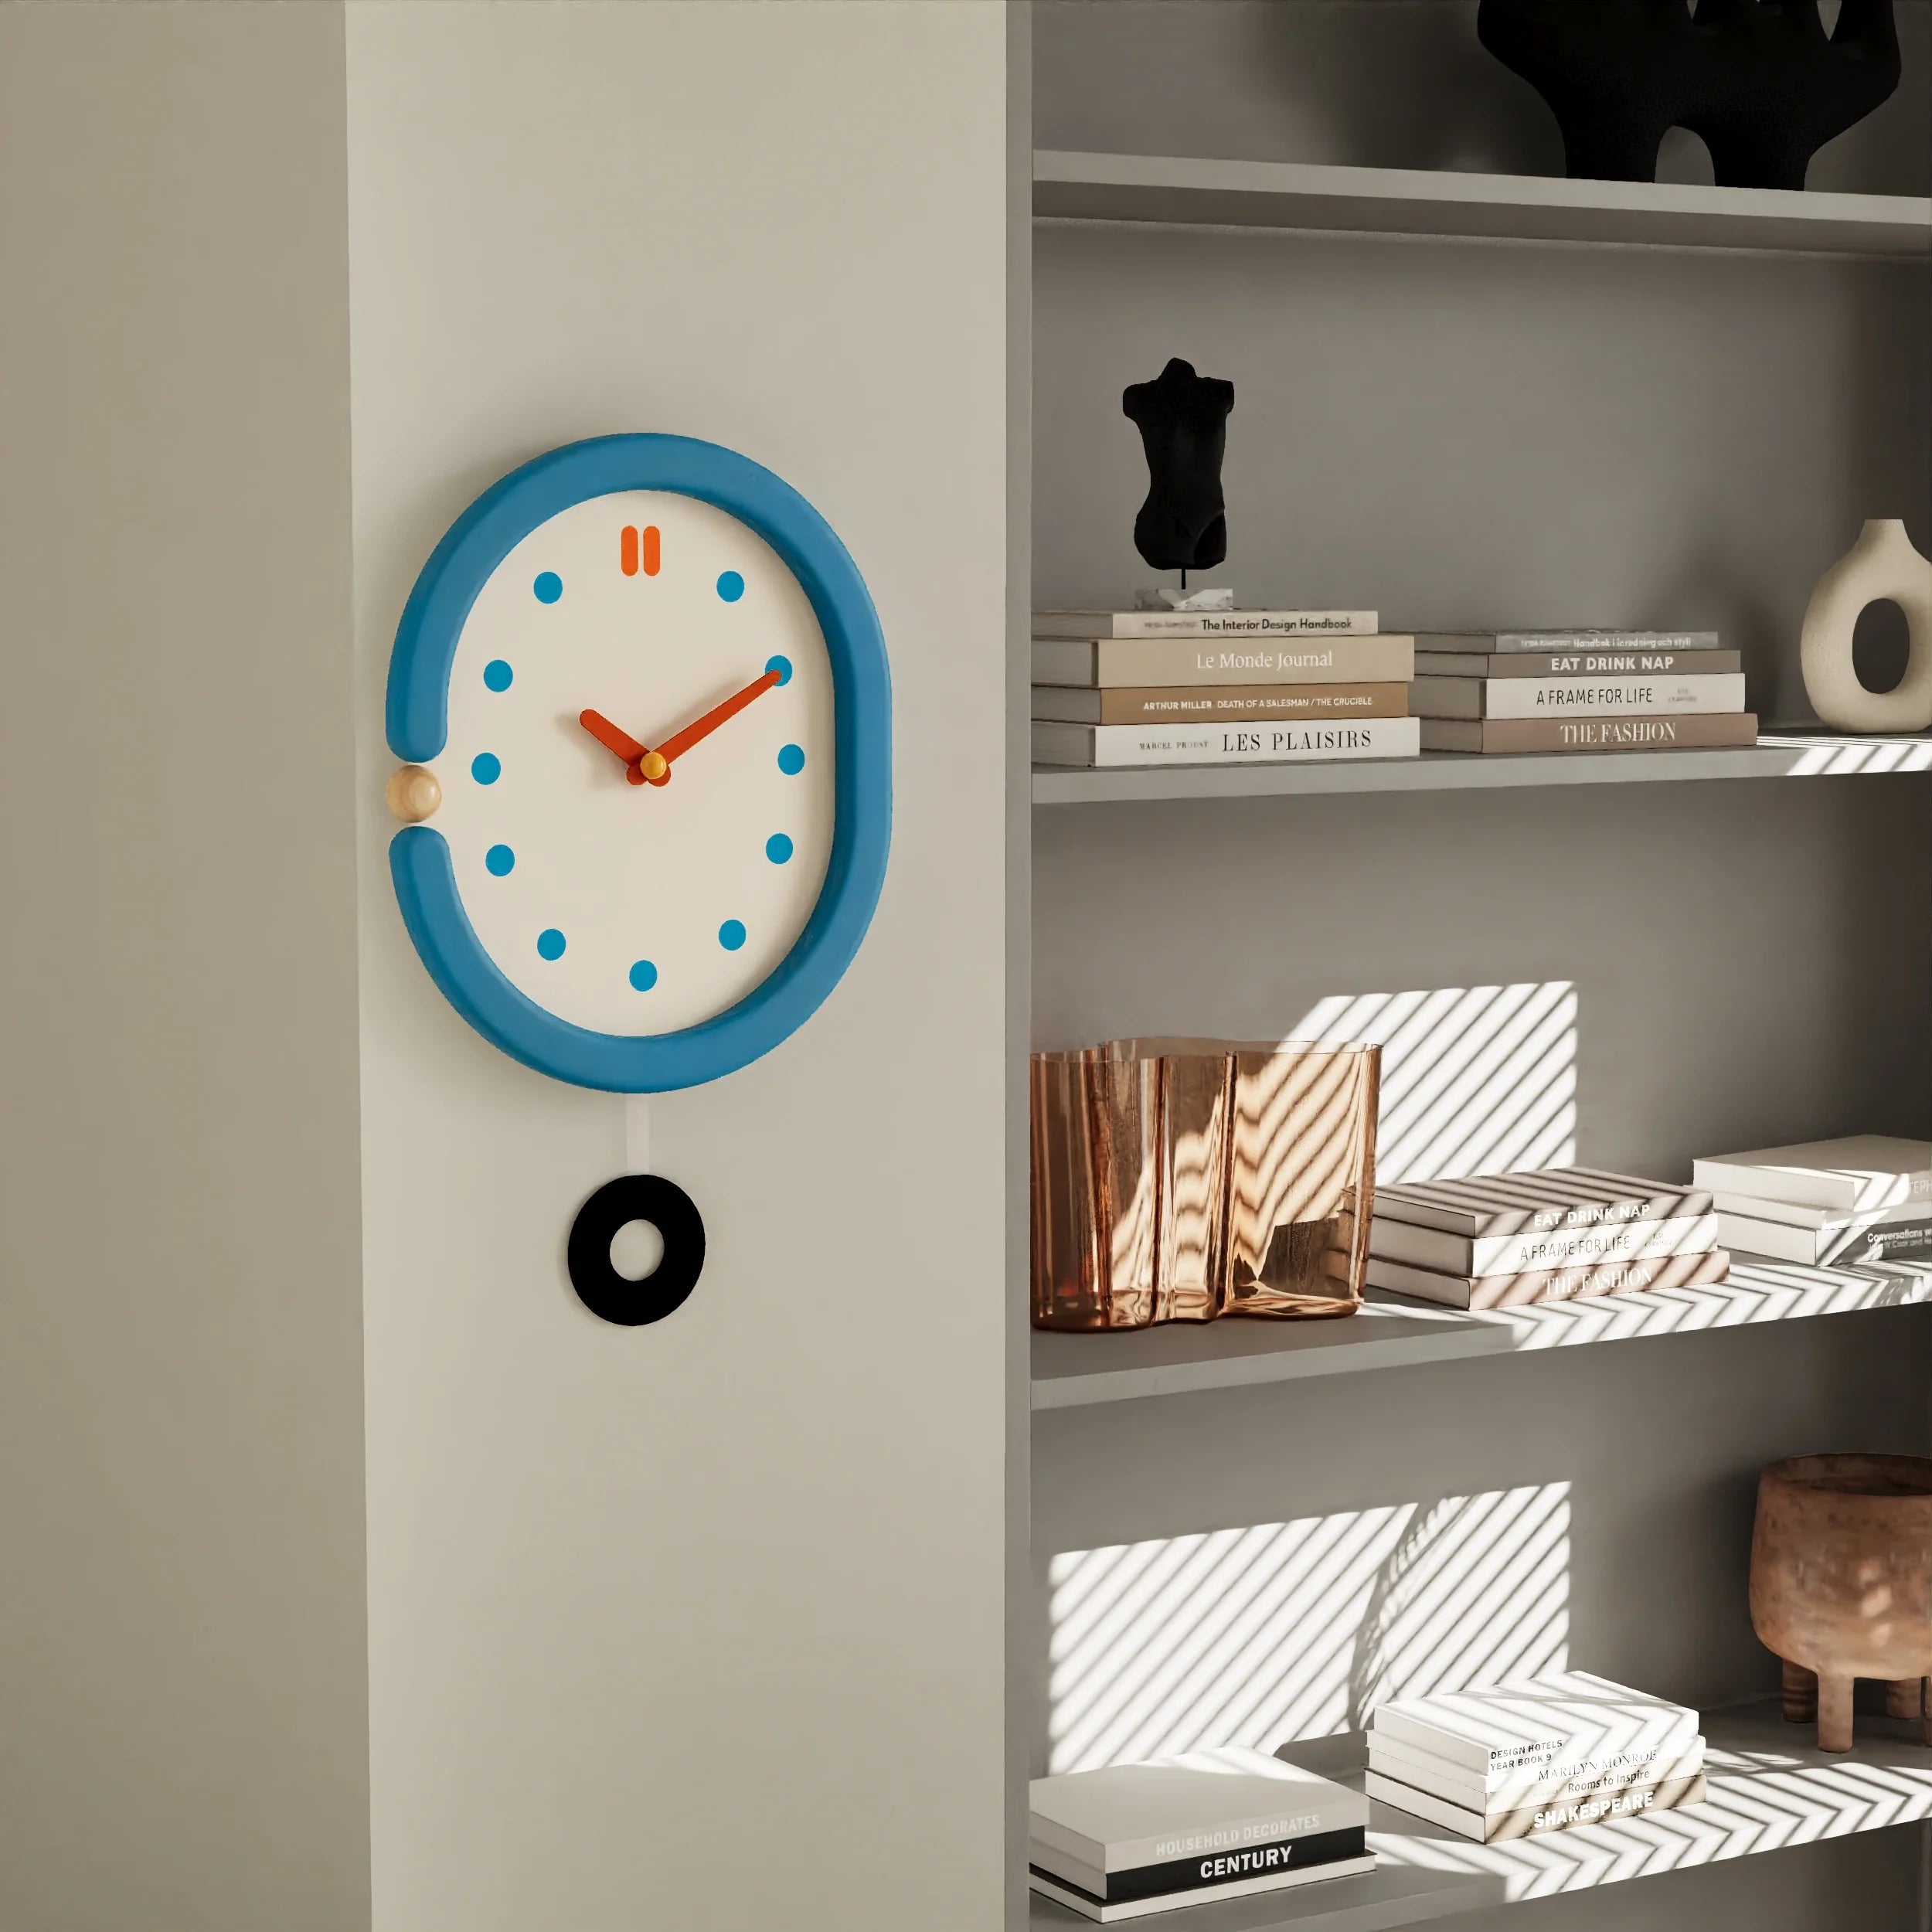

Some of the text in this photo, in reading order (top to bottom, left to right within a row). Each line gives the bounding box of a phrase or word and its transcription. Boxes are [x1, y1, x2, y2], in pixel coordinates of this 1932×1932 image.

[1202, 619, 1219, 630] The
[1223, 619, 1260, 630] Interior
[1262, 619, 1296, 631] Design
[1300, 617, 1352, 630] Handbook
[1657, 638, 1672, 647] och
[1197, 650, 1332, 671] Le Monde Journal
[1551, 655, 1674, 671] EAT DRINK NAP
[1143, 700, 1212, 710] ARTHUR MILLER
[1217, 699, 1243, 709] DEATH
[1246, 699, 1258, 708] OF
[1266, 698, 1309, 708] SALESMAN
[1316, 698, 1332, 706] THE
[1333, 696, 1372, 706] CRUCIBLE
[1536, 690, 1545, 705] A
[1549, 689, 1594, 705] FRAME
[1598, 689, 1623, 703] FOR
[1626, 688, 1653, 703] LIFE
[1223, 730, 1372, 751] LES PLAISIRS
[1560, 722, 1676, 743] THE FASHION
[1140, 741, 1172, 750] MARCEL
[1534, 1204, 1651, 1226] EAT DRINK NAP
[1520, 1247, 1528, 1260] A
[1532, 1241, 1575, 1260] FRAME
[1579, 1238, 1602, 1253] FOR
[1605, 1235, 1630, 1252] LIFE
[1543, 1267, 1652, 1295] THE FASHION
[1491, 1740, 1563, 1760] DESIGN HOTELS
[1491, 1759, 1515, 1771] YEAR
[1518, 1754, 1543, 1767] BOOK
[1538, 1750, 1658, 1781] MARILYN MONROE
[1568, 1769, 1650, 1793] Rooms to Inspire
[1534, 1791, 1654, 1829] SHAKESPEARE
[1156, 1815, 1321, 1857] HOUSEHOLD DECORATES
[1200, 1845, 1292, 1879] CENTURY
